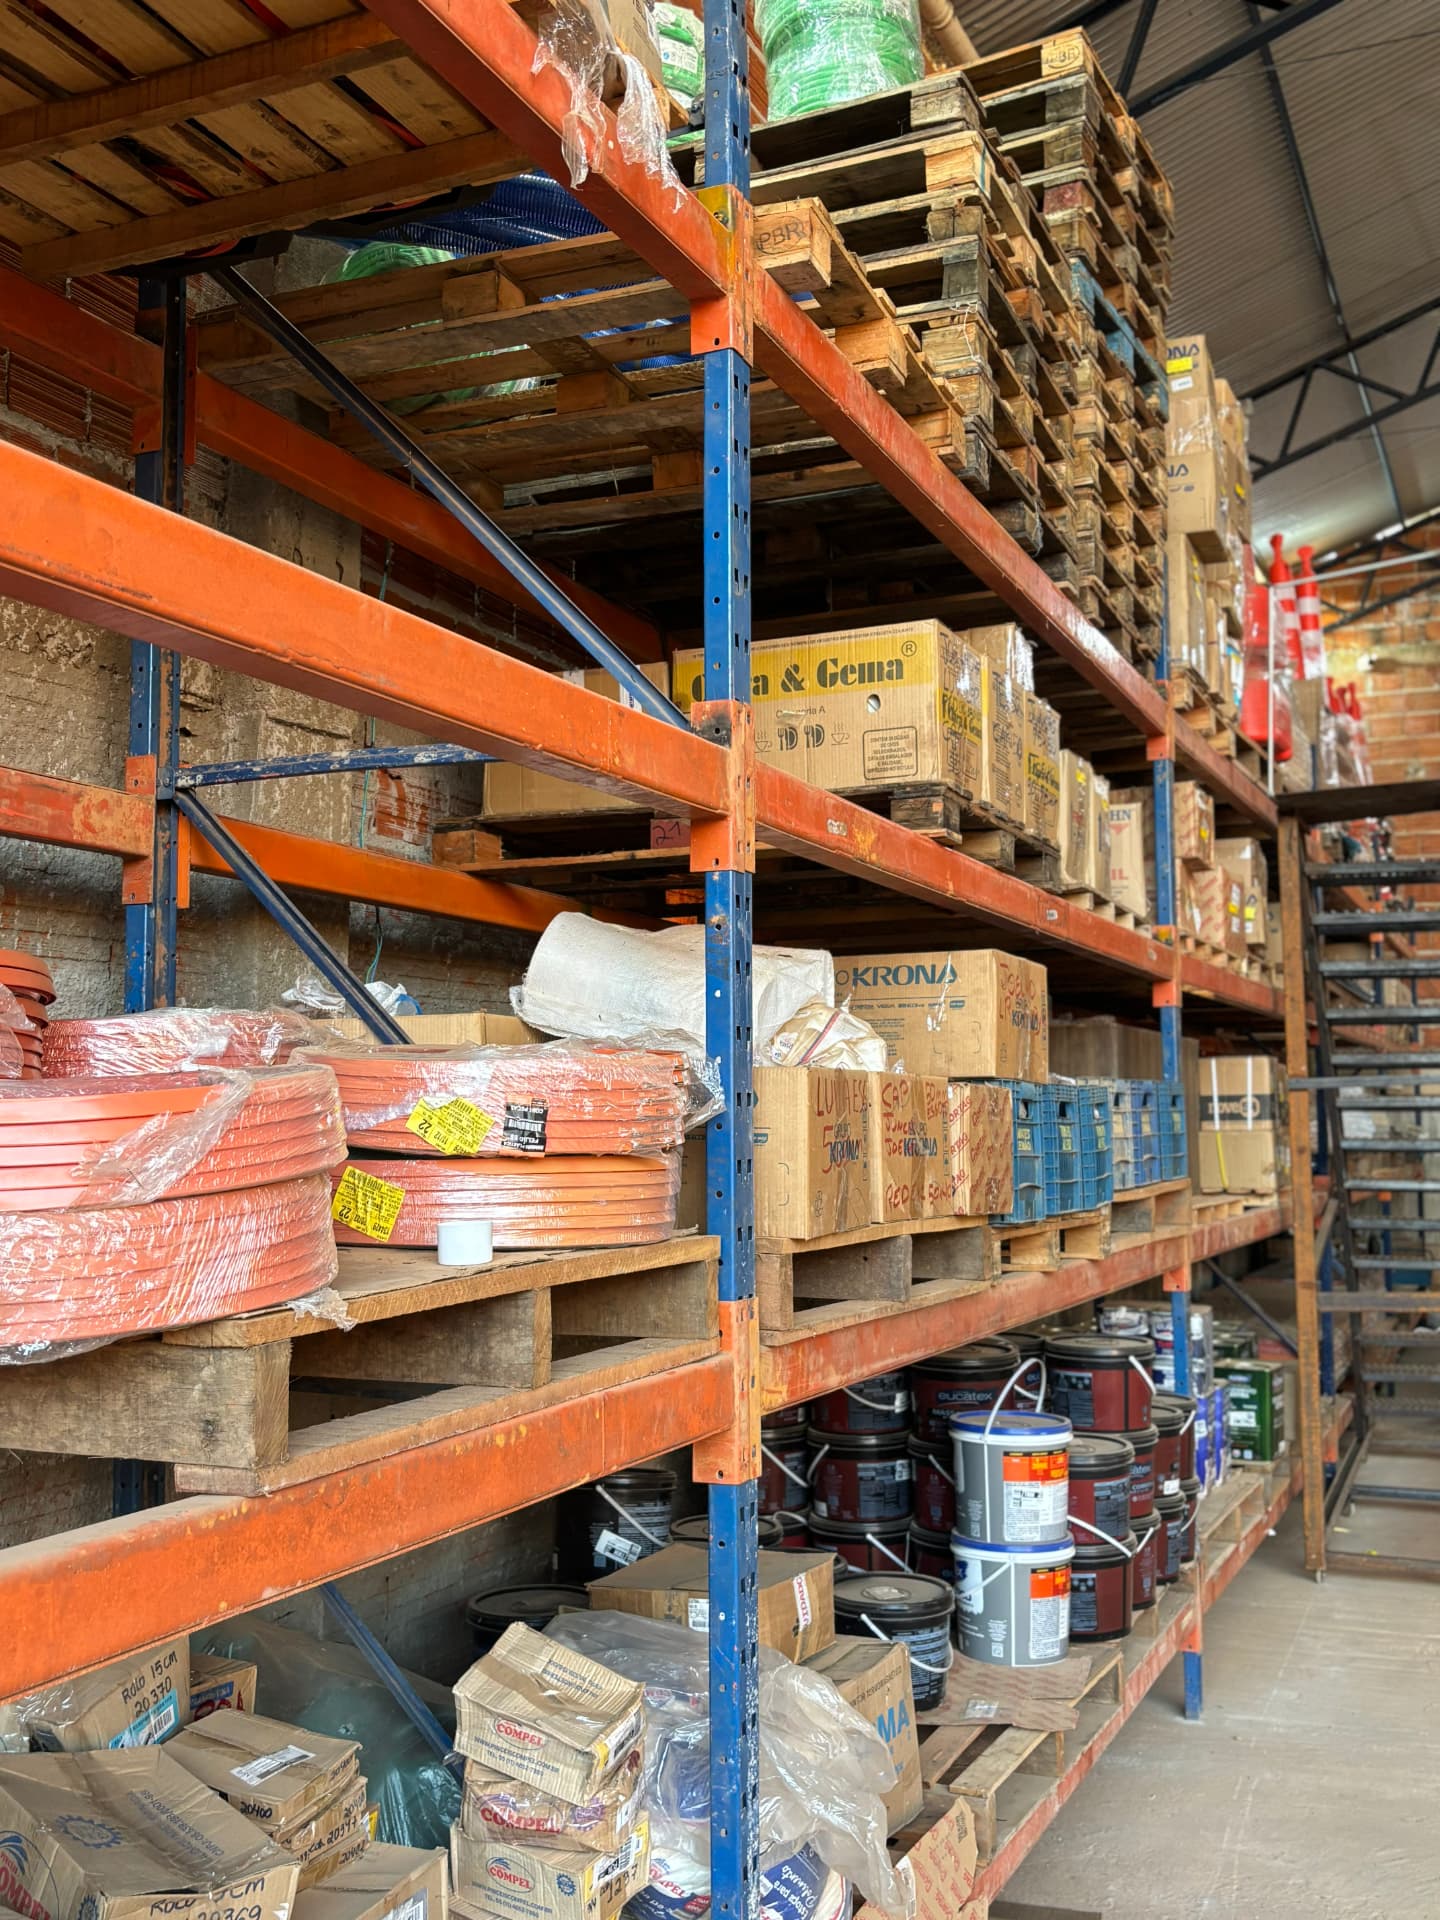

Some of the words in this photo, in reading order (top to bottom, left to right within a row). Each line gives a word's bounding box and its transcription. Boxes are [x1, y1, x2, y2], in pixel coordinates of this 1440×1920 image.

[817, 658, 904, 688] Gema
[852, 963, 958, 987] KRONA
[418, 1118, 432, 1133] 22
[338, 1205, 352, 1220] 22
[938, 1390, 993, 1402] eucatex
[496, 1723, 544, 1749] COMPEL
[240, 1801, 273, 1819] 20400
[480, 1806, 560, 1834] COMPEL
[489, 1866, 531, 1890] COMPEL
